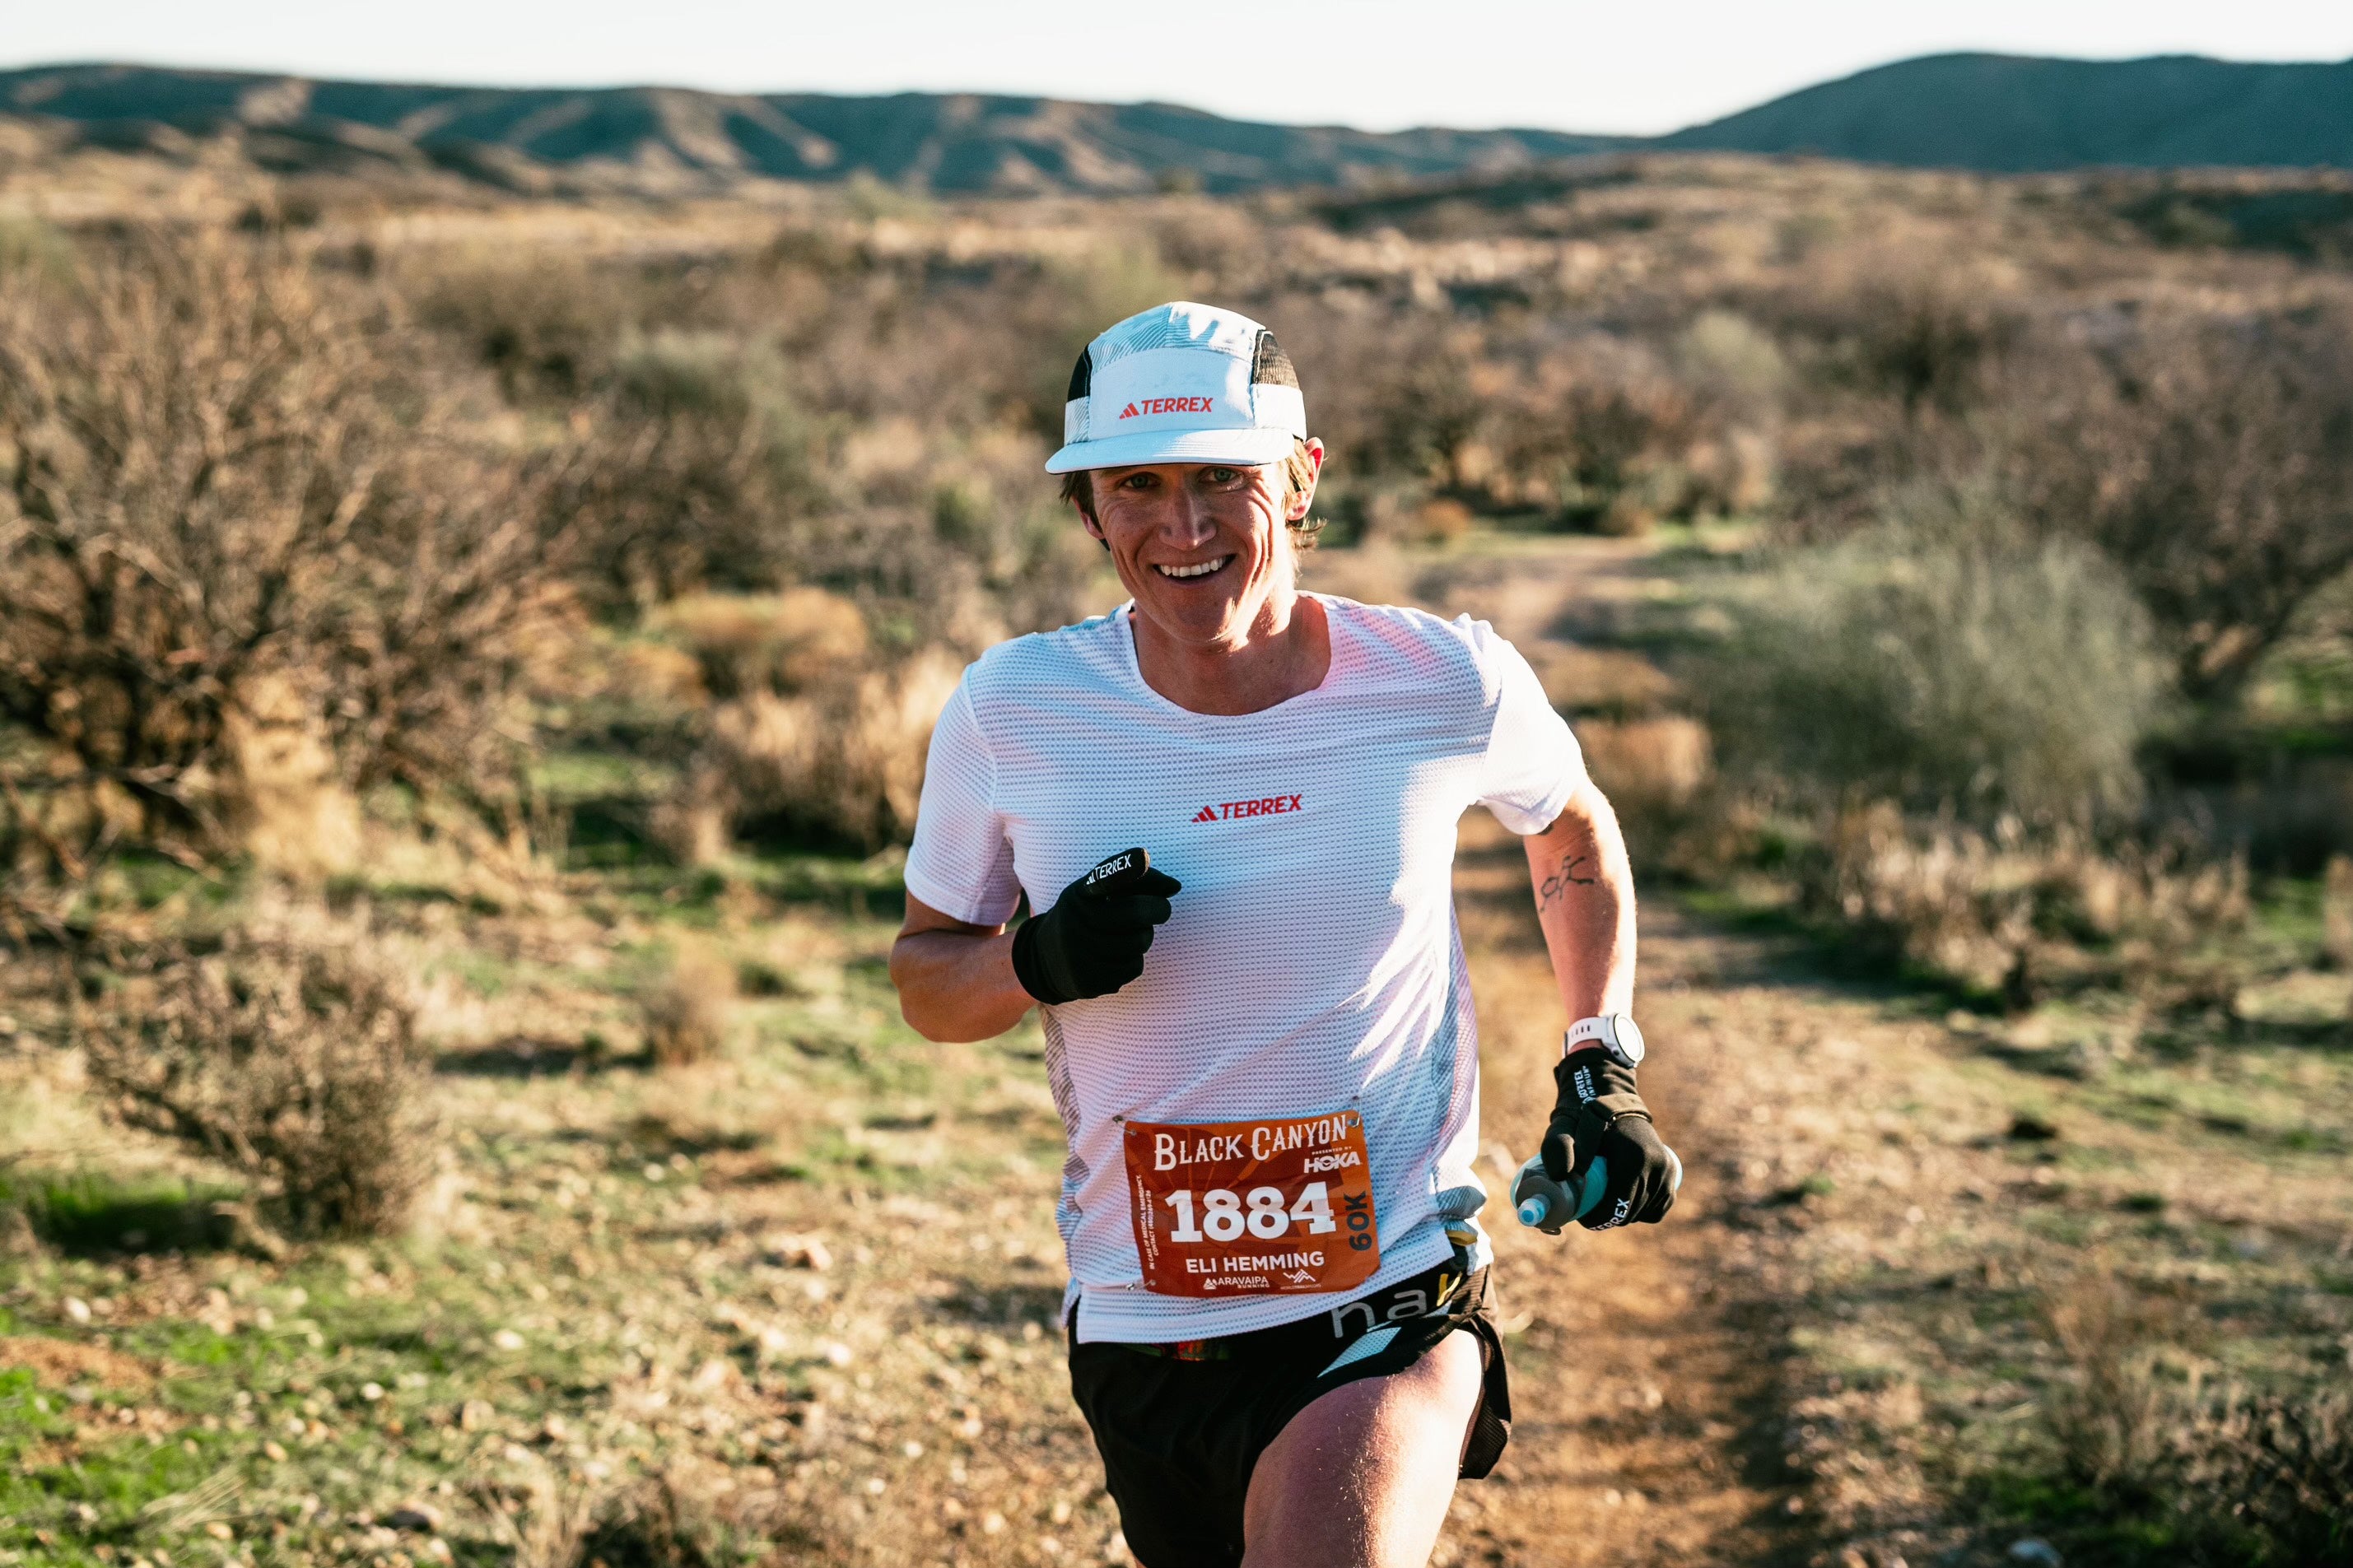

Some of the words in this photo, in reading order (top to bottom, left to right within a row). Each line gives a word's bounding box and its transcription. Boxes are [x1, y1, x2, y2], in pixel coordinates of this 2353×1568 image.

[1141, 397, 1214, 415] TERREX
[1219, 793, 1302, 820] TERREX
[1094, 854, 1132, 882] TERREX
[1154, 1133, 1244, 1170] BLACK
[1251, 1114, 1348, 1161] CANYON
[1303, 1151, 1361, 1174] HOKA
[1139, 1211, 1149, 1238] MEDICAL
[1165, 1181, 1336, 1243] 1884
[1344, 1191, 1373, 1251] 60K
[1144, 1239, 1151, 1248] OF
[1145, 1248, 1154, 1262] CASE
[1148, 1230, 1159, 1256] CONTACT
[1186, 1257, 1217, 1273] ELI
[1223, 1251, 1325, 1273] HEMMING
[1216, 1276, 1269, 1286] ARAVAIPA
